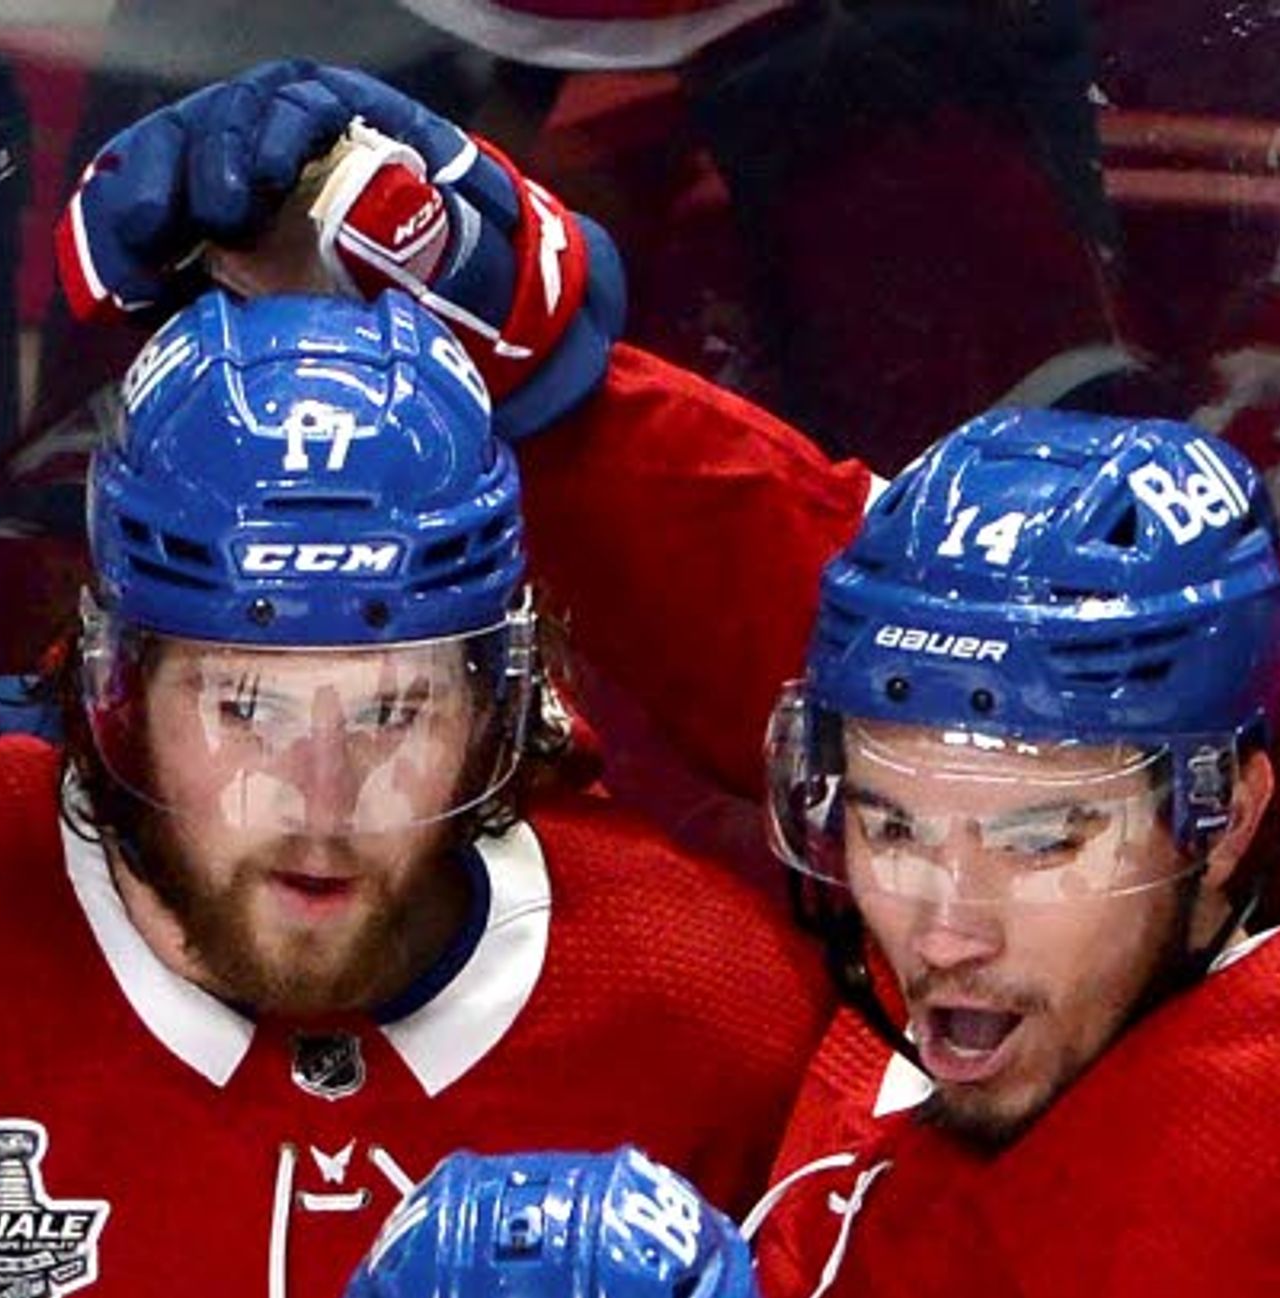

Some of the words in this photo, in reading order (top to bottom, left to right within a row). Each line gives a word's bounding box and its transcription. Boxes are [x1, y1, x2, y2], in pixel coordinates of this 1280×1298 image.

[283, 402, 355, 471] 17
[1128, 439, 1250, 545] Bell
[242, 543, 400, 573] CCM
[937, 505, 1026, 565] 14
[874, 626, 1009, 662] BAUER
